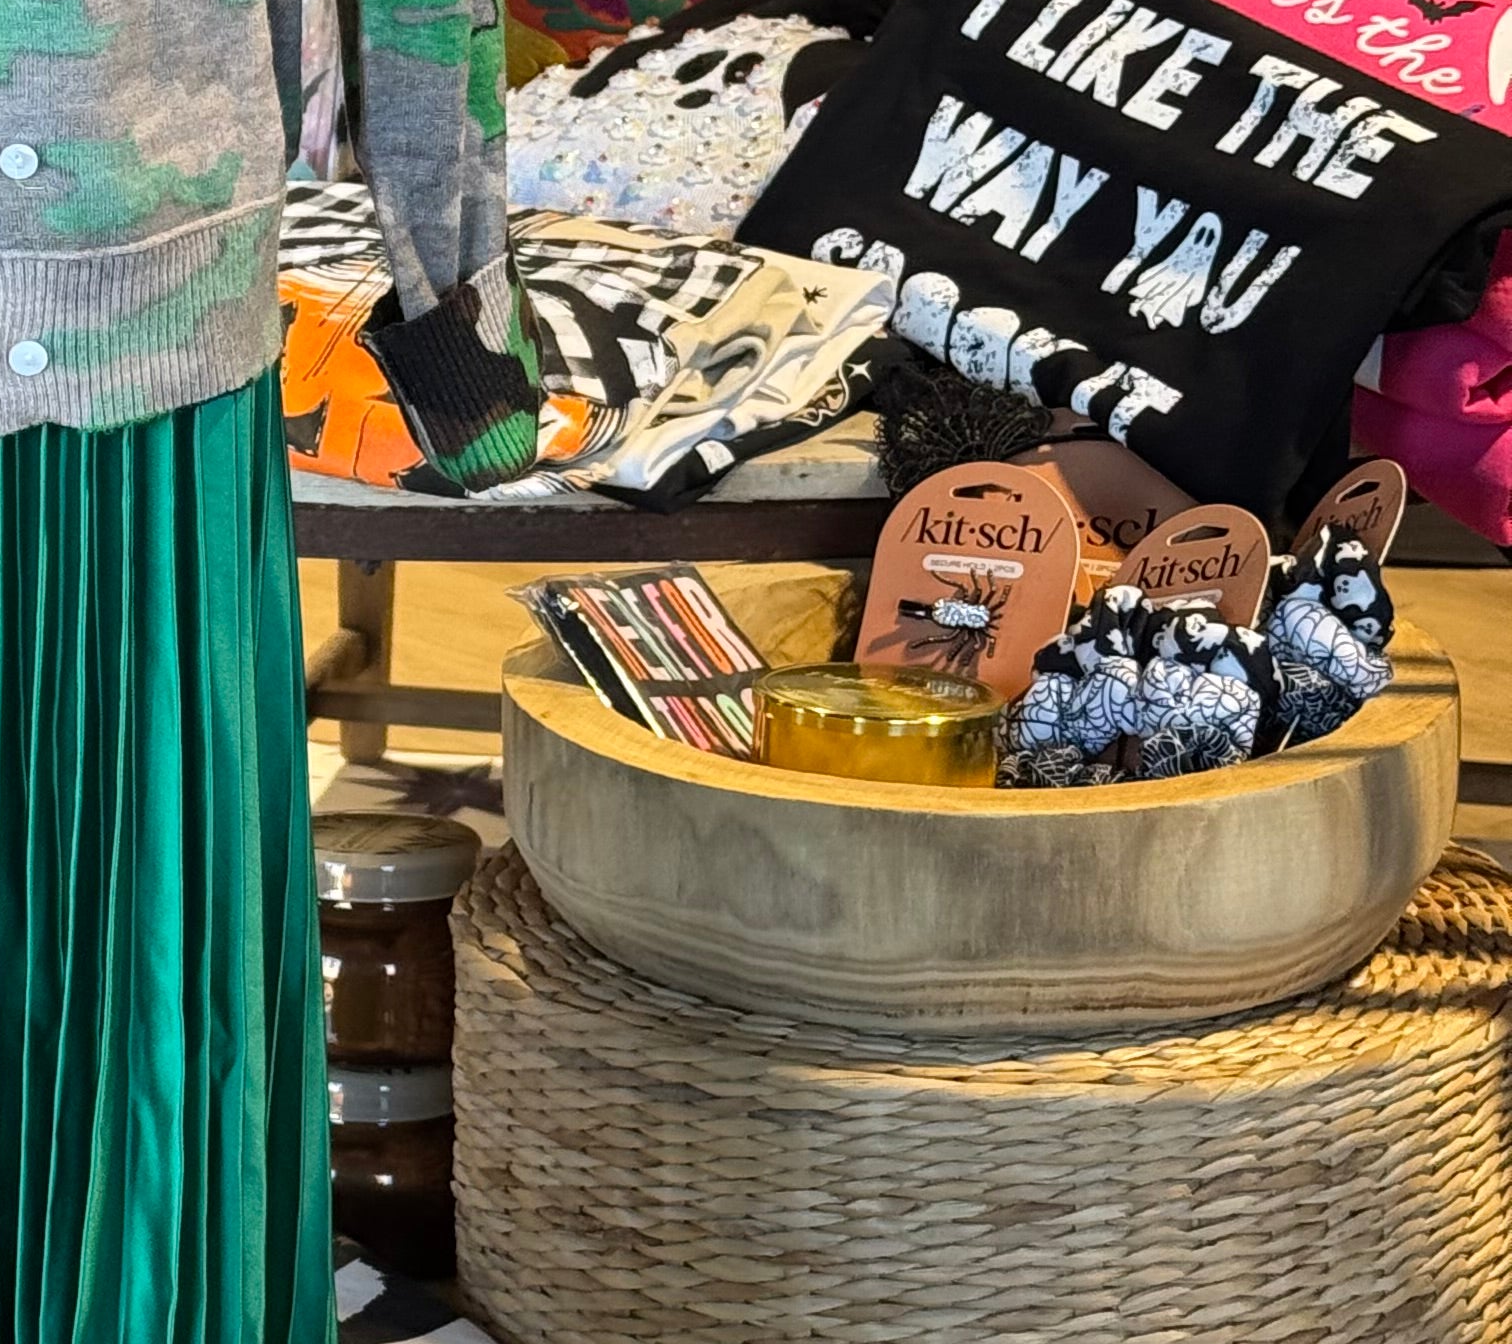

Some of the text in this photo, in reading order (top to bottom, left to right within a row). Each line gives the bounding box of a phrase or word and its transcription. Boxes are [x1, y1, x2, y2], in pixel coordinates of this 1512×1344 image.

[1356, 15, 1464, 95] the
[1216, 54, 1438, 199] THE
[904, 94, 1301, 334] WAY YOU
[641, 577, 763, 677] FOR
